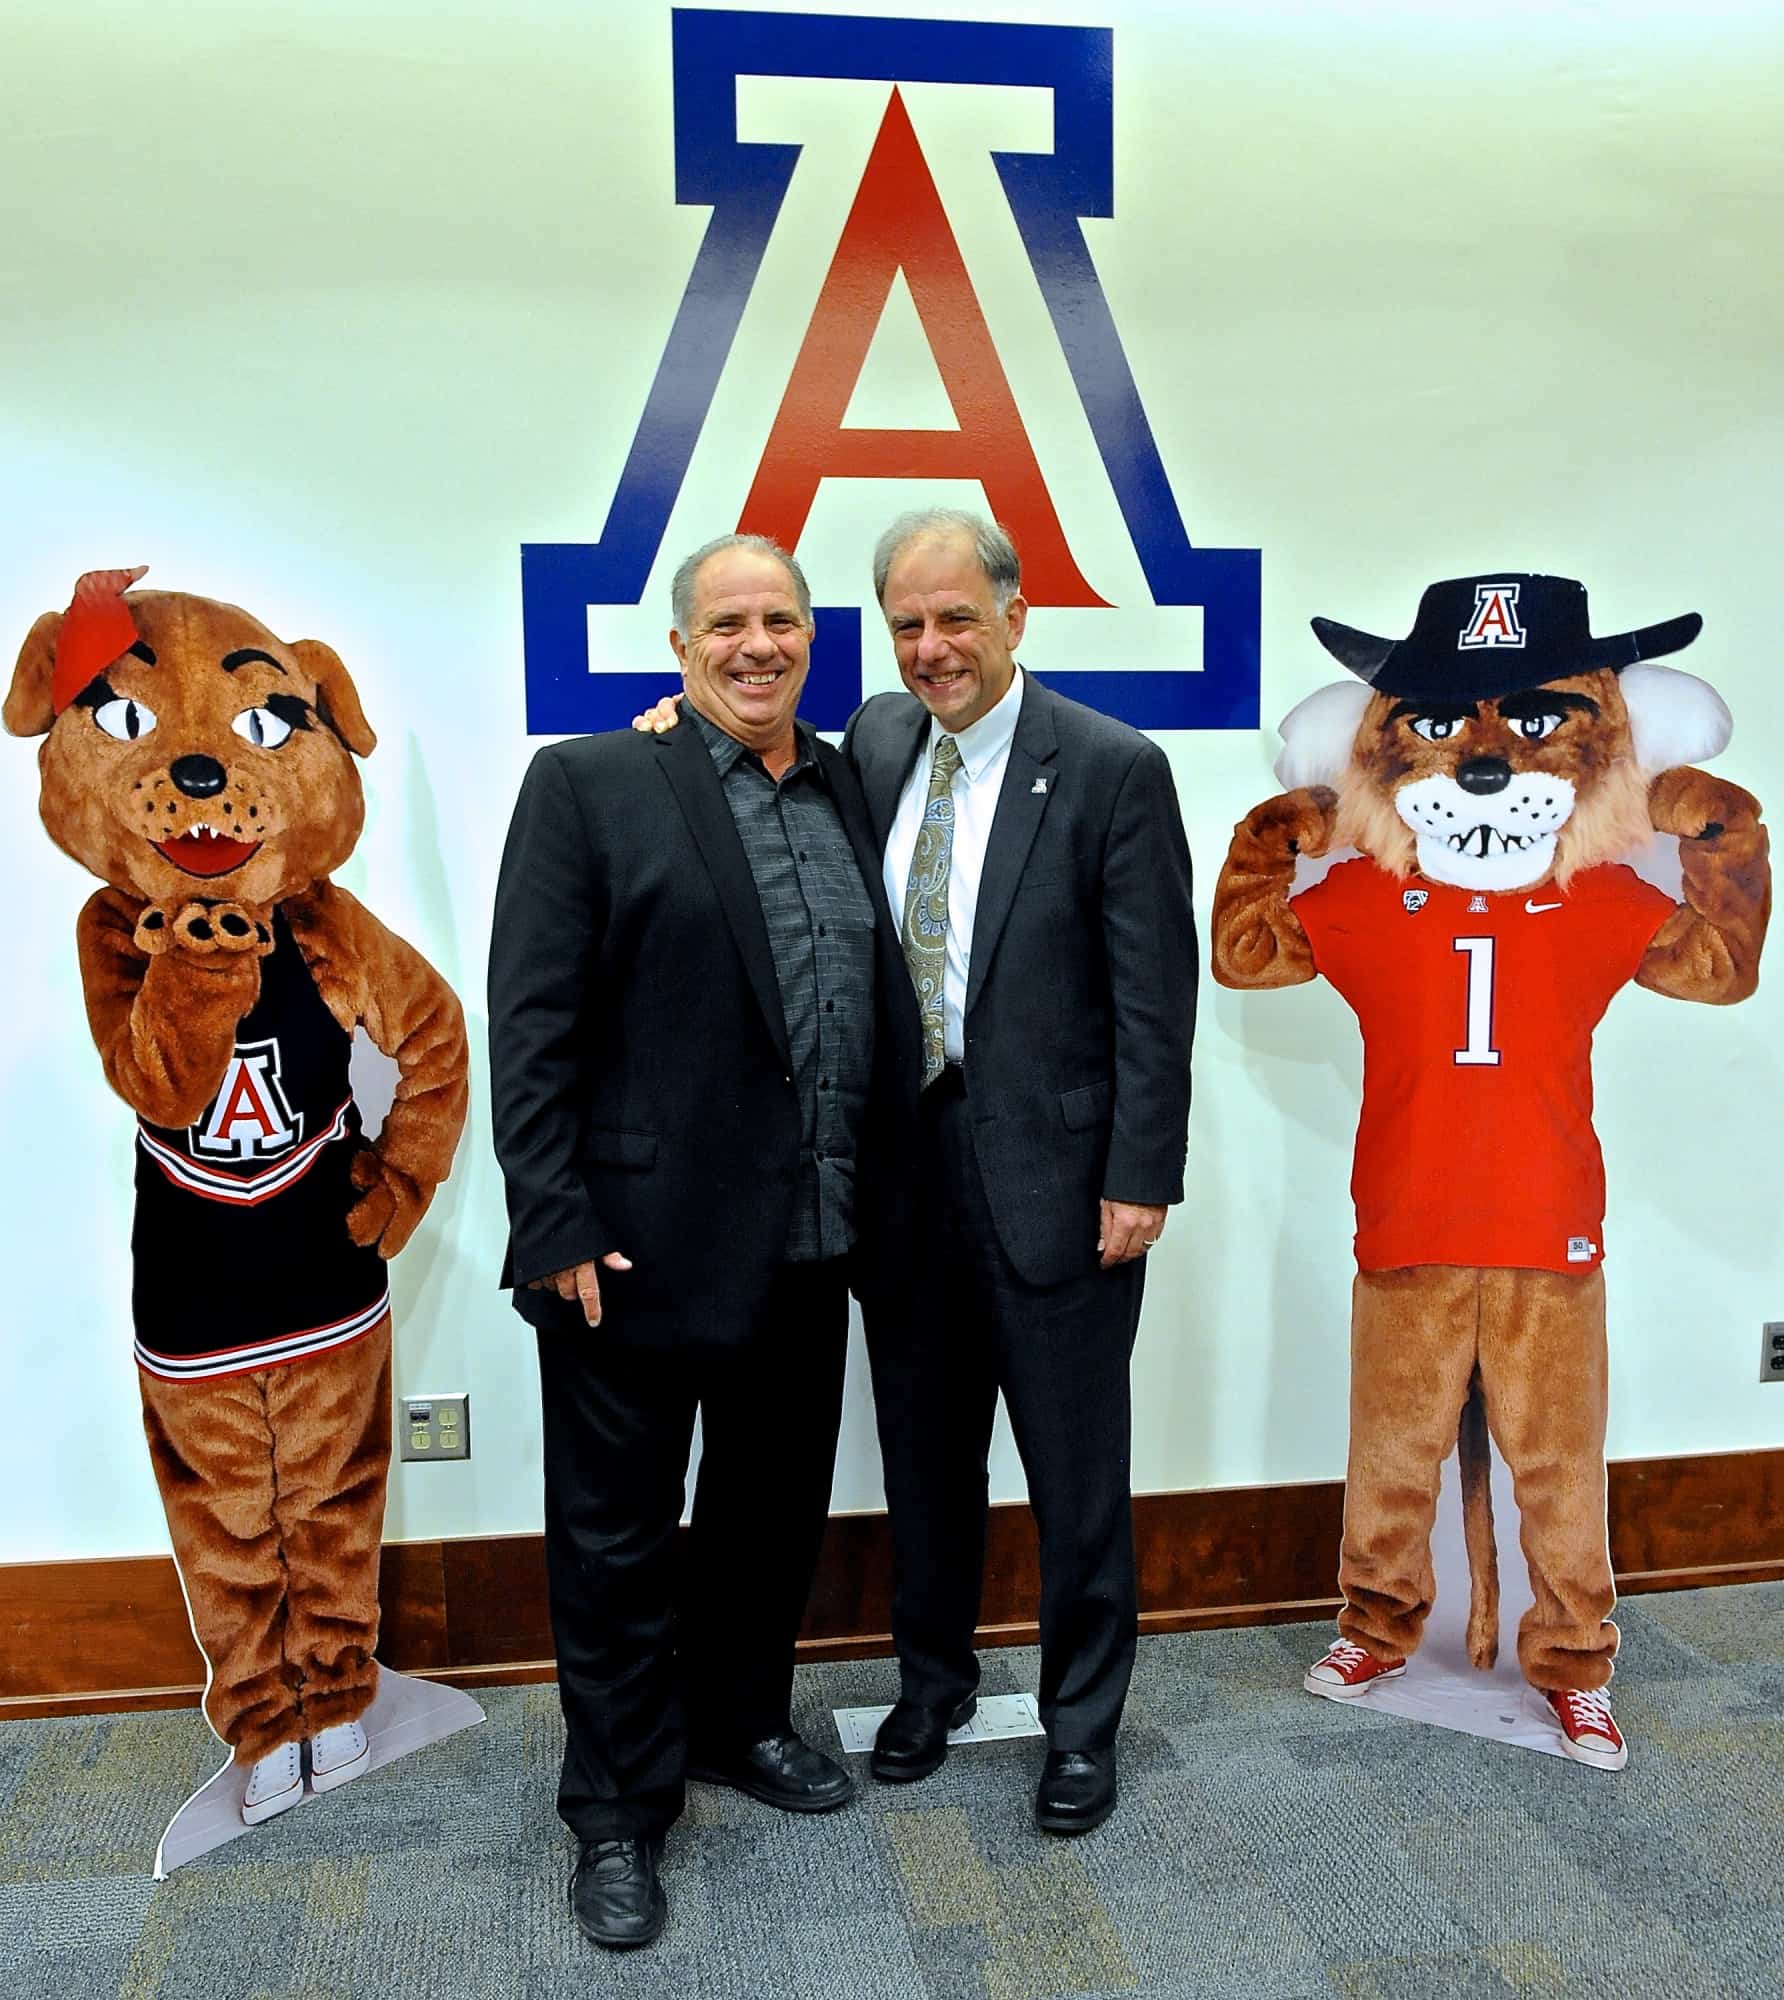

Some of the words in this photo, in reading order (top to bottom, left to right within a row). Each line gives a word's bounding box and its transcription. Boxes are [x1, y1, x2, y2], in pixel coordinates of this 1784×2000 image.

[521, 8, 1262, 735] A
[1458, 583, 1527, 650] A
[1467, 896, 1488, 912] A
[1453, 936, 1501, 1066] 1
[188, 1038, 304, 1162] A
